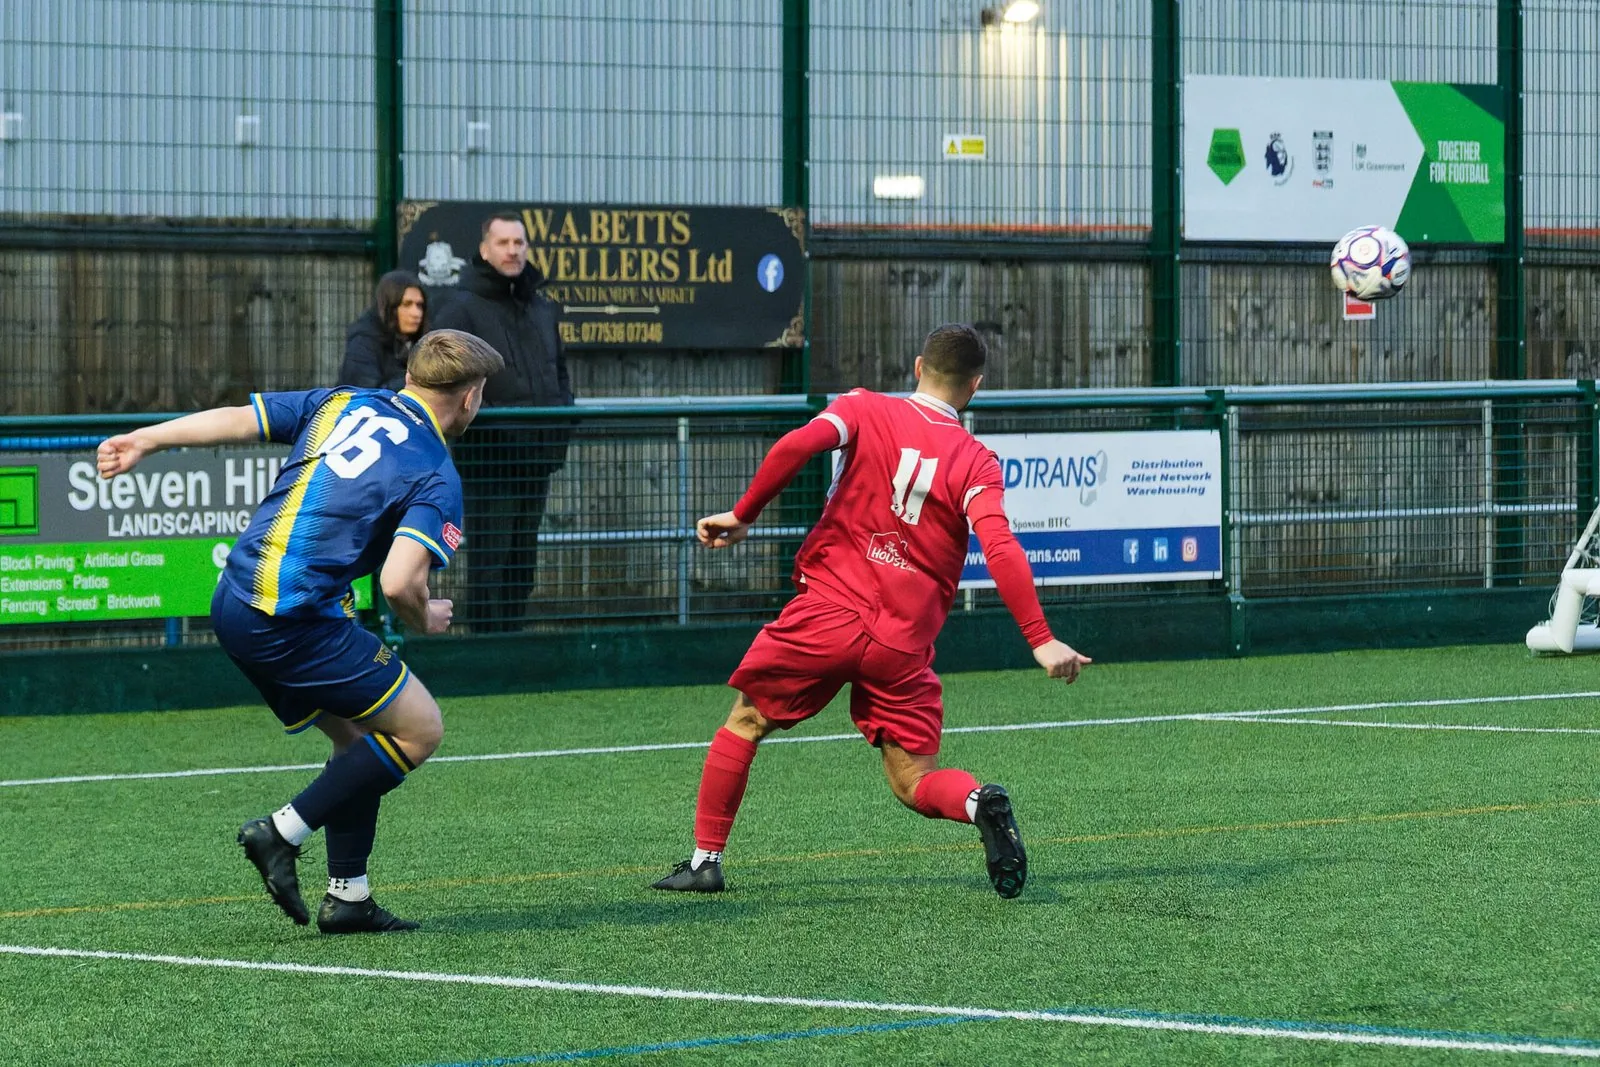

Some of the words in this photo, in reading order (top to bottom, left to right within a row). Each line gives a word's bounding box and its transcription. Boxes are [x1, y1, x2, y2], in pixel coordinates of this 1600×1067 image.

[1437, 140, 1480, 161] TOGETHER
[1429, 162, 1446, 183] FOR
[1450, 162, 1490, 184] FOOTBALL
[521, 208, 691, 245] W.A.BETTS
[527, 247, 681, 281] WELLERS
[688, 249, 733, 283] Ltd
[313, 405, 409, 479] 16
[1132, 459, 1203, 470] Distribution
[68, 461, 211, 512] Steven
[891, 447, 939, 526] 11
[1123, 474, 1157, 483] Pallet
[1160, 472, 1212, 482] Network
[1126, 485, 1206, 496] Warehousing
[108, 510, 251, 537] LANDSCAPING
[1048, 517, 1072, 529] BTFC
[0, 557, 32, 571] Block
[35, 556, 75, 571] Paving
[84, 553, 128, 568] Artificial
[131, 551, 164, 567] Grass
[0, 578, 63, 592] Extensions
[73, 575, 109, 589] Patios
[0, 601, 47, 615] Fencing
[57, 598, 97, 612] Screed
[107, 595, 161, 609] Brickwork
